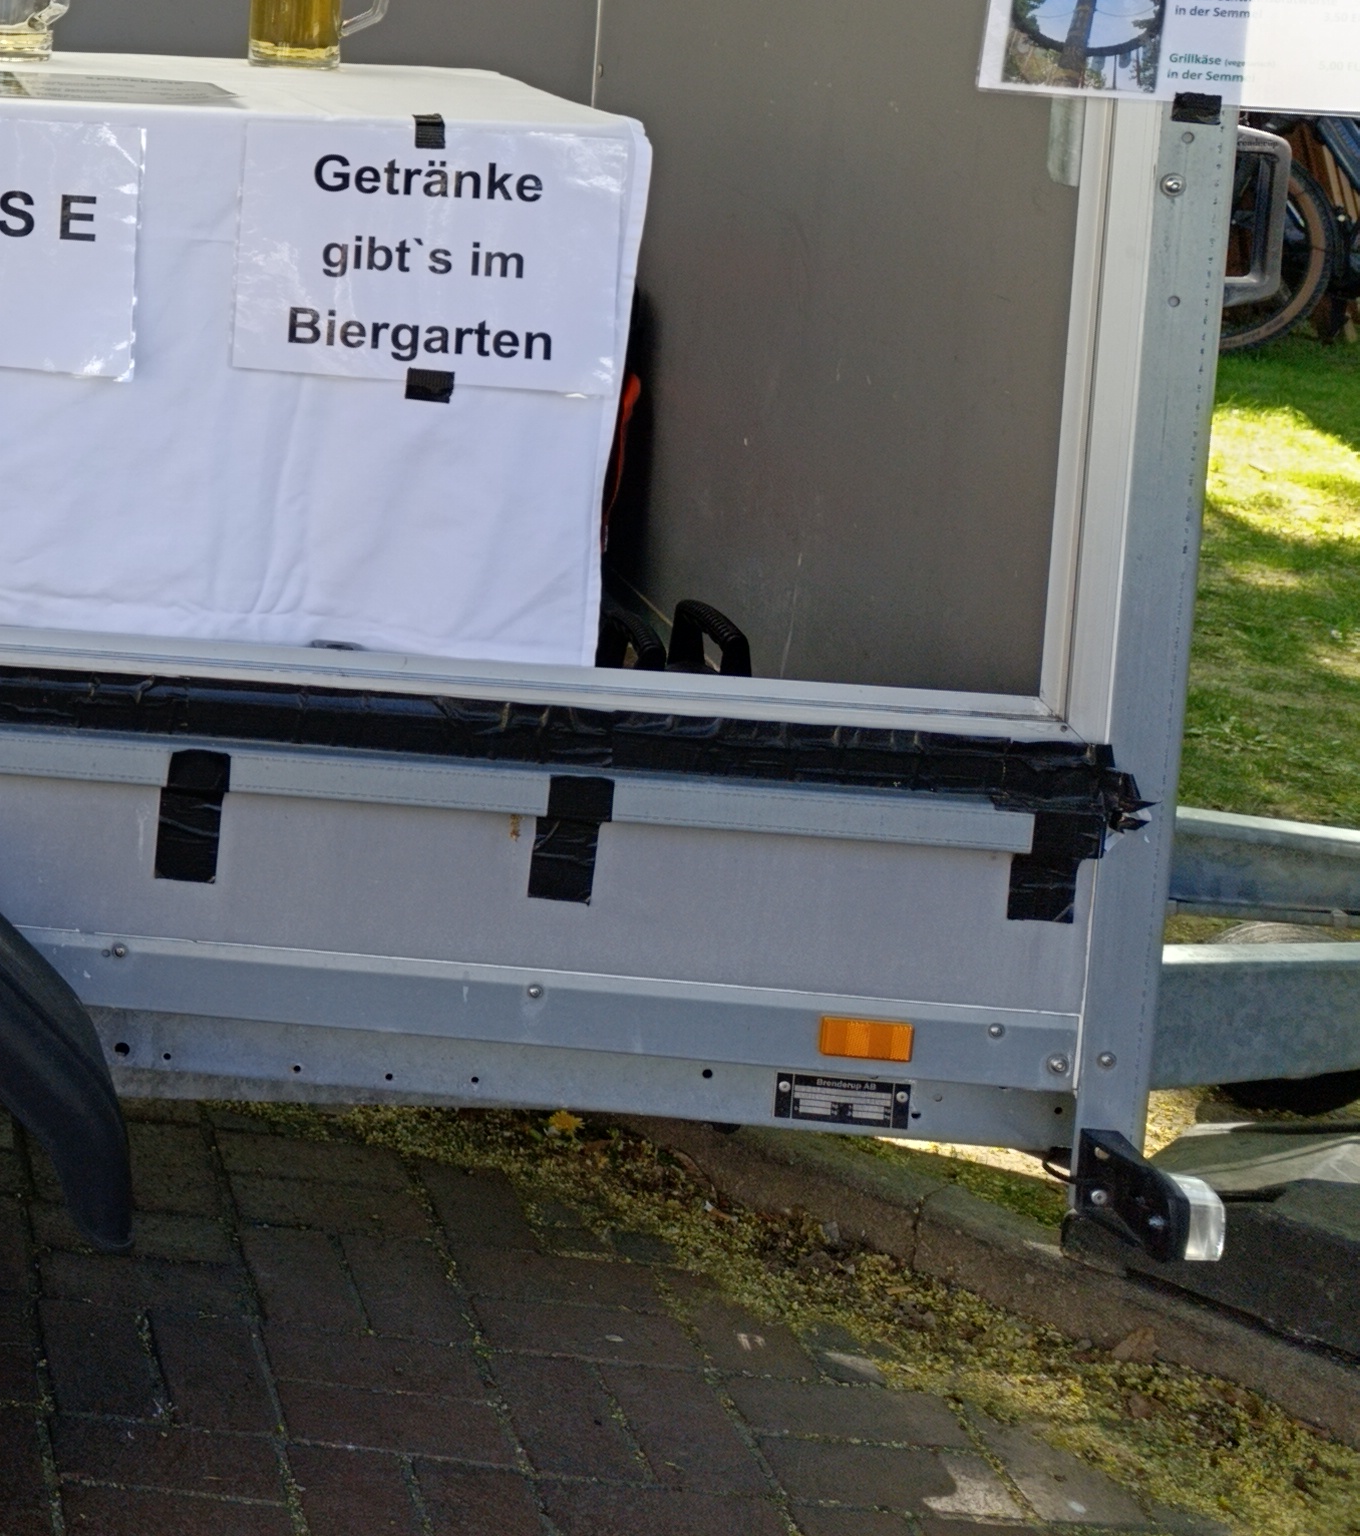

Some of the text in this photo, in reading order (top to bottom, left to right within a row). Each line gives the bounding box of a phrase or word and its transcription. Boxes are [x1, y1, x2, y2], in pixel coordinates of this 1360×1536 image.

[1175, 5, 1185, 15] in
[1188, 5, 1210, 17] der
[1213, 7, 1262, 18] Semmel
[1169, 53, 1221, 65] Grillkäse
[1168, 69, 1254, 83] in der Semmel
[314, 154, 543, 202] Getränke
[471, 242, 524, 278] im
[288, 306, 552, 362] Biergarten
[817, 1079, 861, 1090] Brenderup
